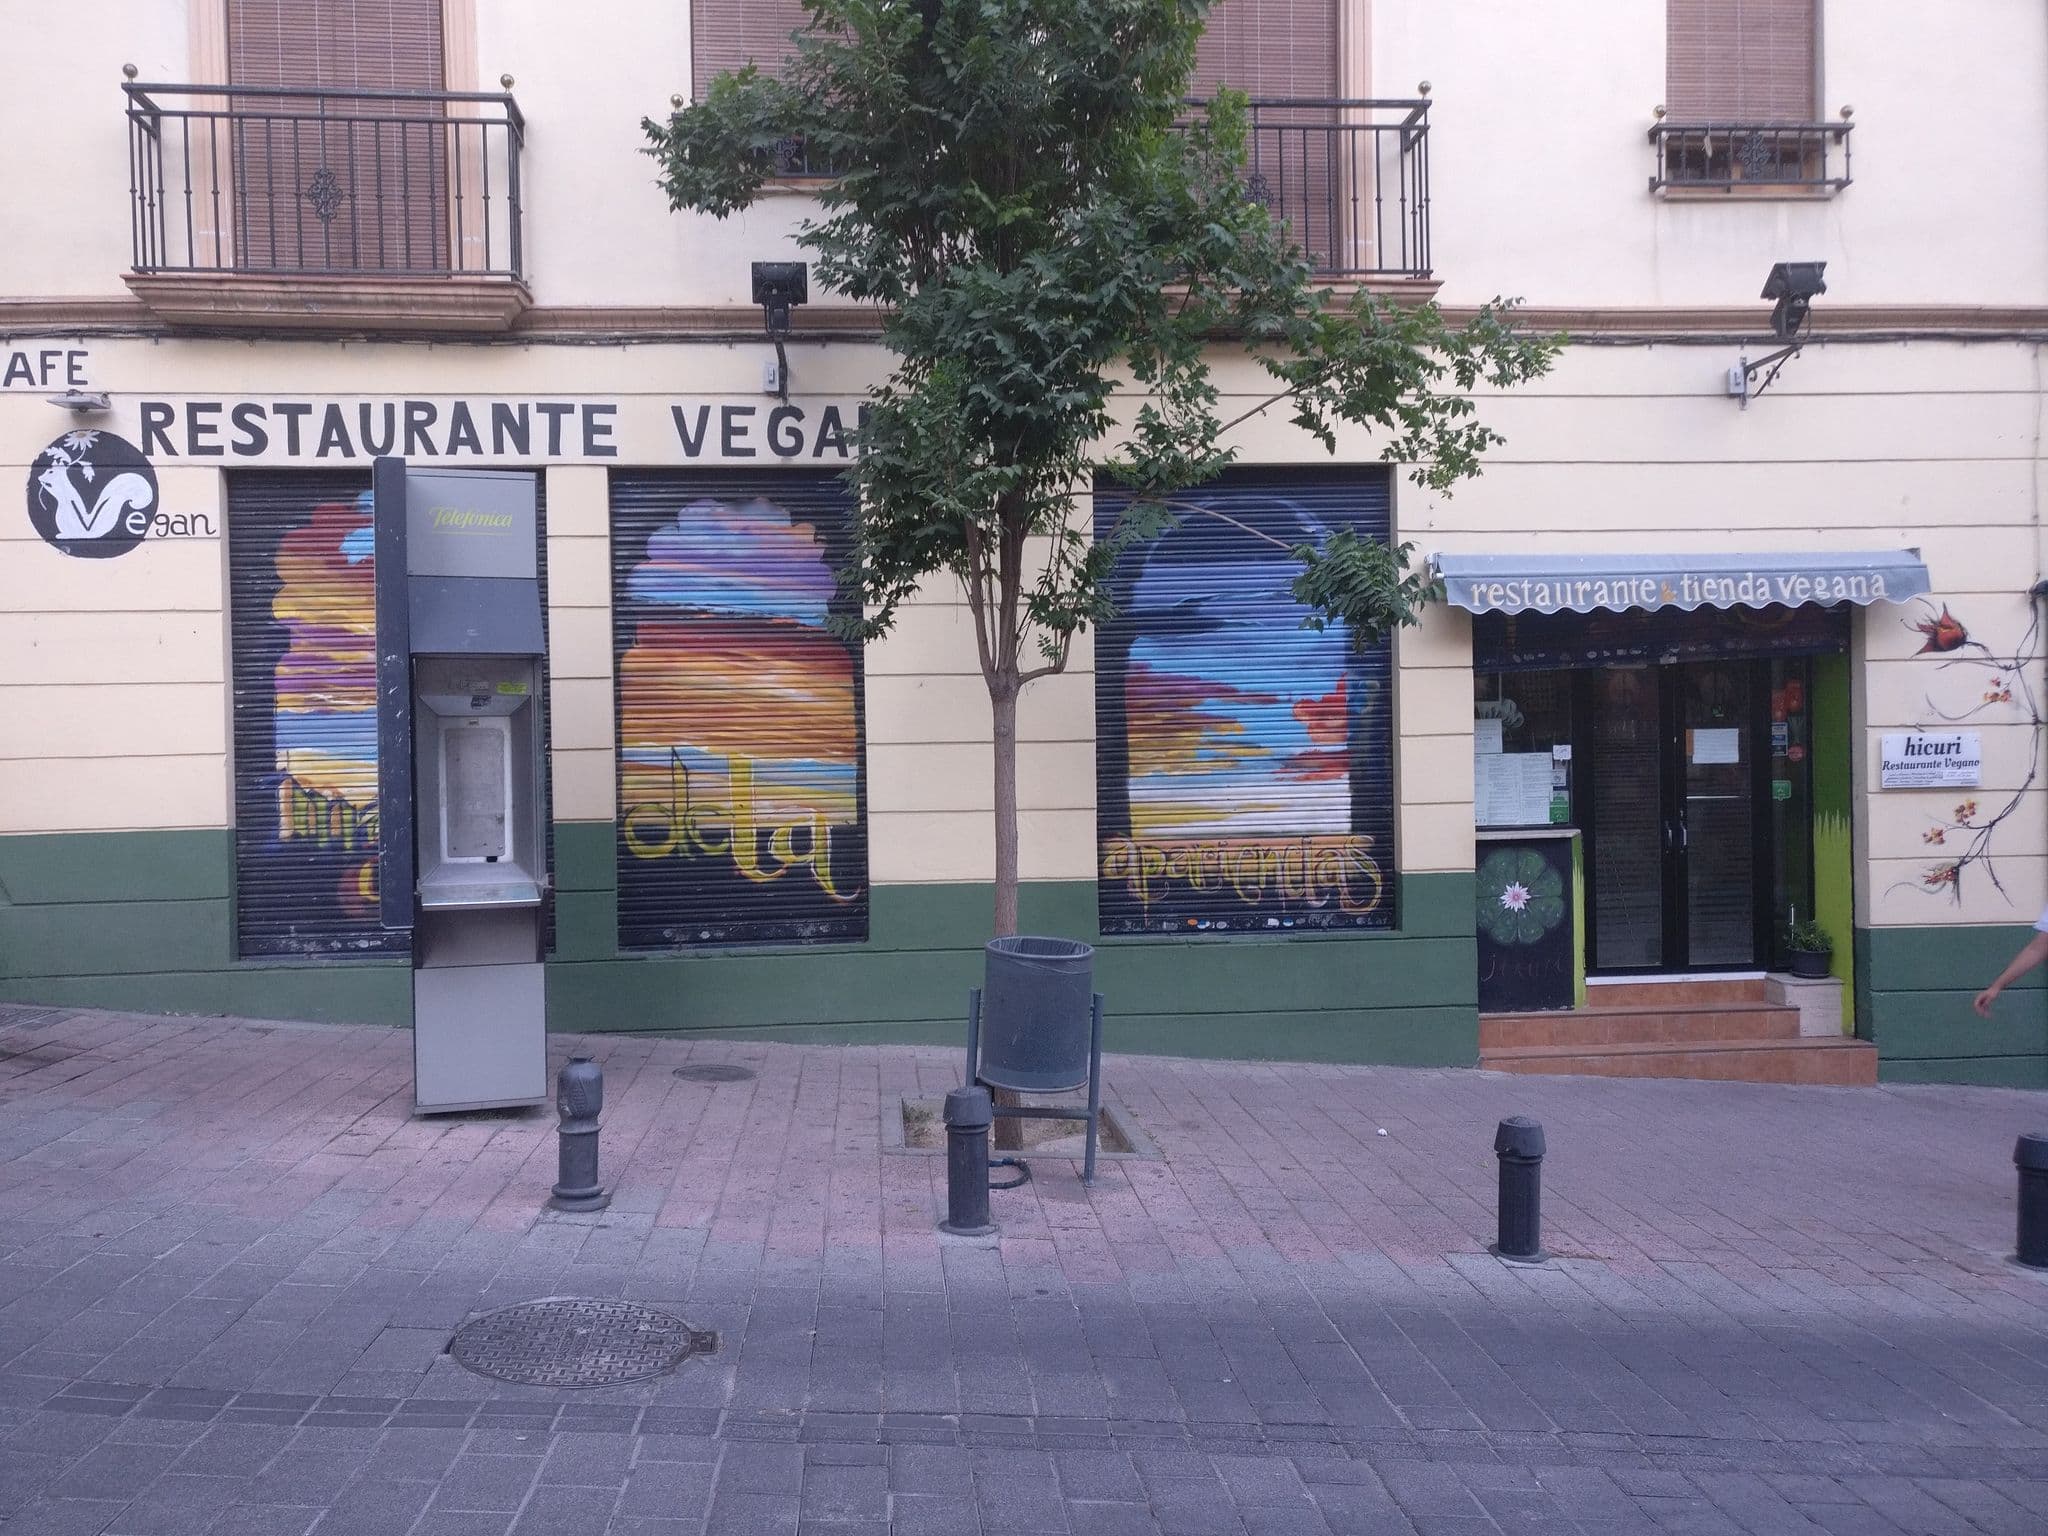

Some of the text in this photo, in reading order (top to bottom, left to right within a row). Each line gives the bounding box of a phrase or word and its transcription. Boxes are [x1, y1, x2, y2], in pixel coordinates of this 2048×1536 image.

[2, 350, 89, 387] AFE
[140, 401, 618, 458] RESTAURANTE
[48, 470, 217, 539] Vegan
[1470, 577, 1656, 607] restaurante
[1680, 572, 1772, 602] tienda
[1776, 573, 1889, 601] vegana
[1882, 757, 1980, 771] Restaurante Vegano
[1904, 736, 1962, 756] hicuri
